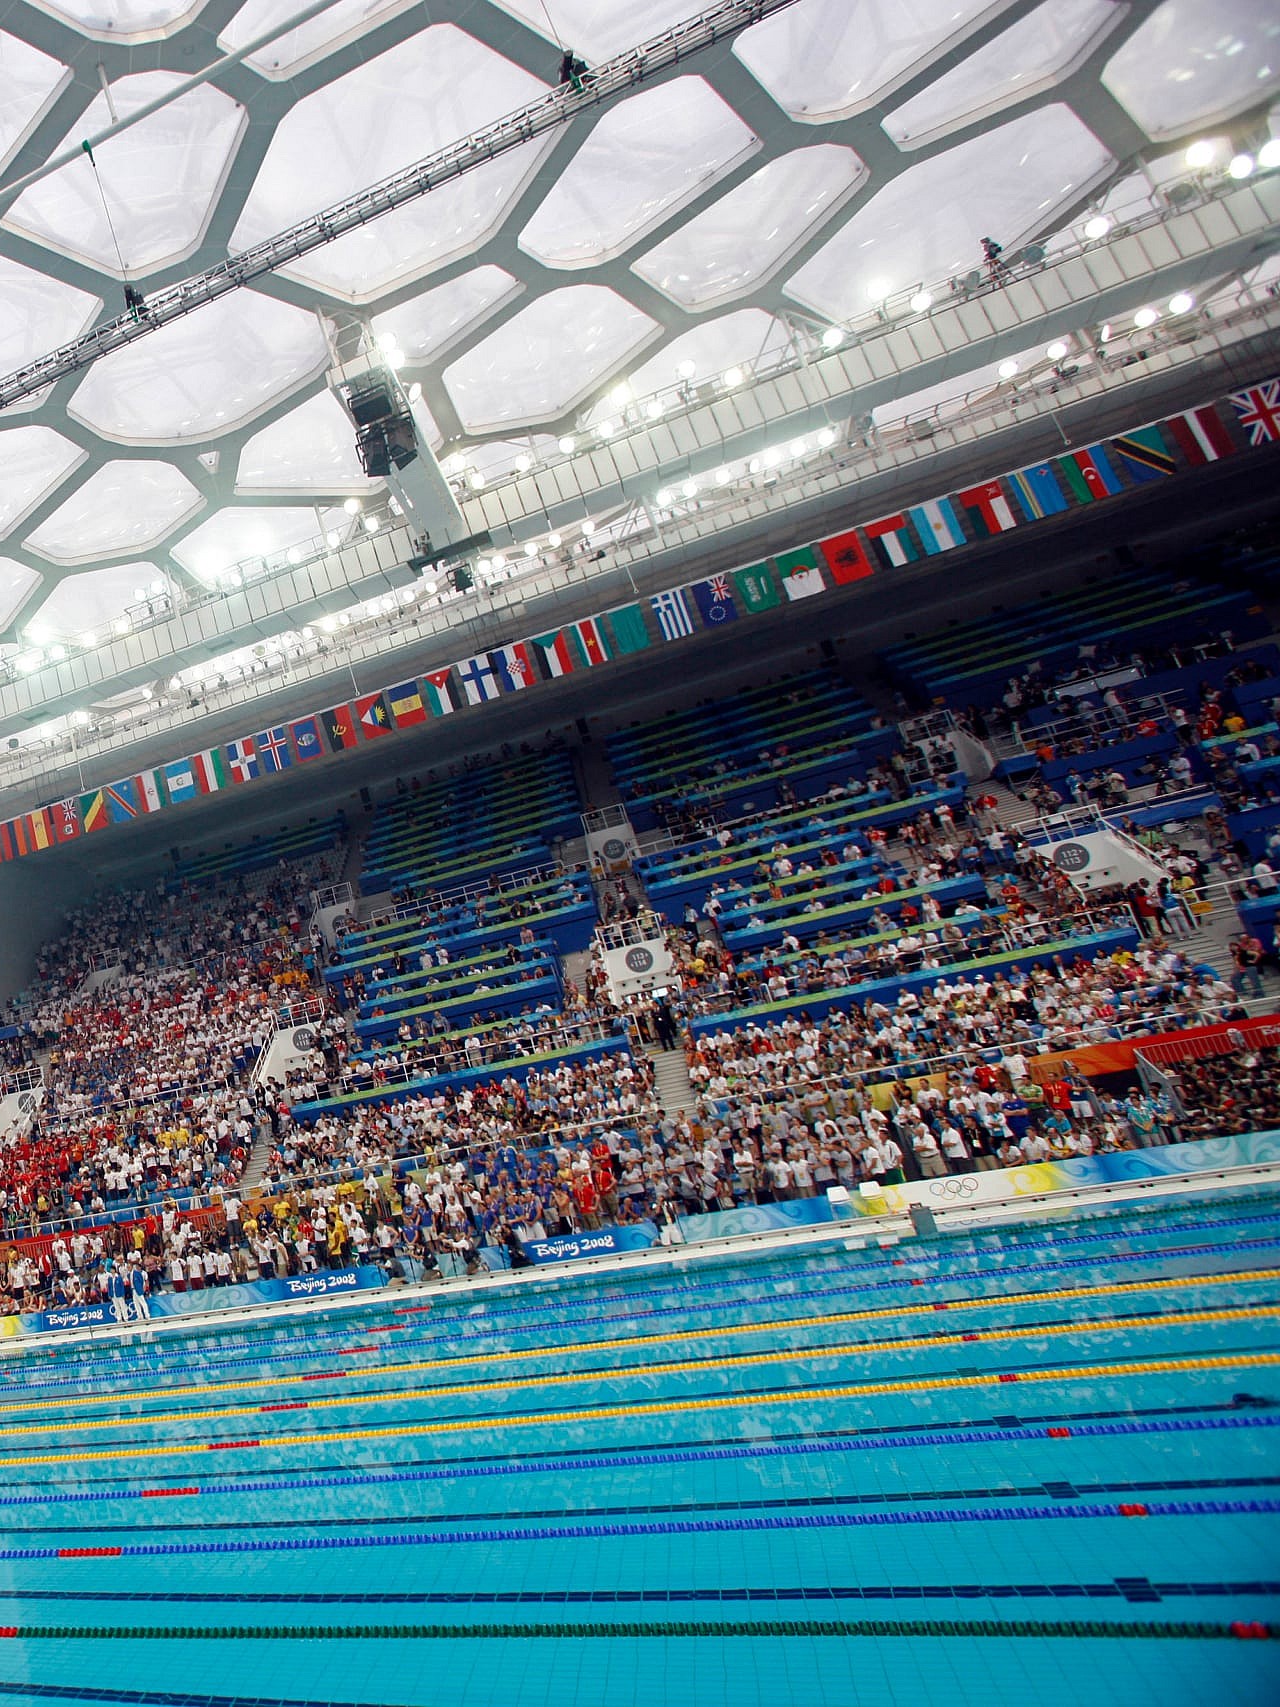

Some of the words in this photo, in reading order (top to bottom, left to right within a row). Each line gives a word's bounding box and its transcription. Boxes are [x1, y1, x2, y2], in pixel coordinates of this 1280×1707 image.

[1062, 849, 1078, 858] 112
[532, 1240, 580, 1258] Beijing
[580, 1234, 615, 1250] 2008
[286, 1277, 326, 1292] Beijing
[327, 1273, 356, 1286] 2008
[46, 1312, 78, 1326] Beijing
[80, 1309, 104, 1320] 2008
